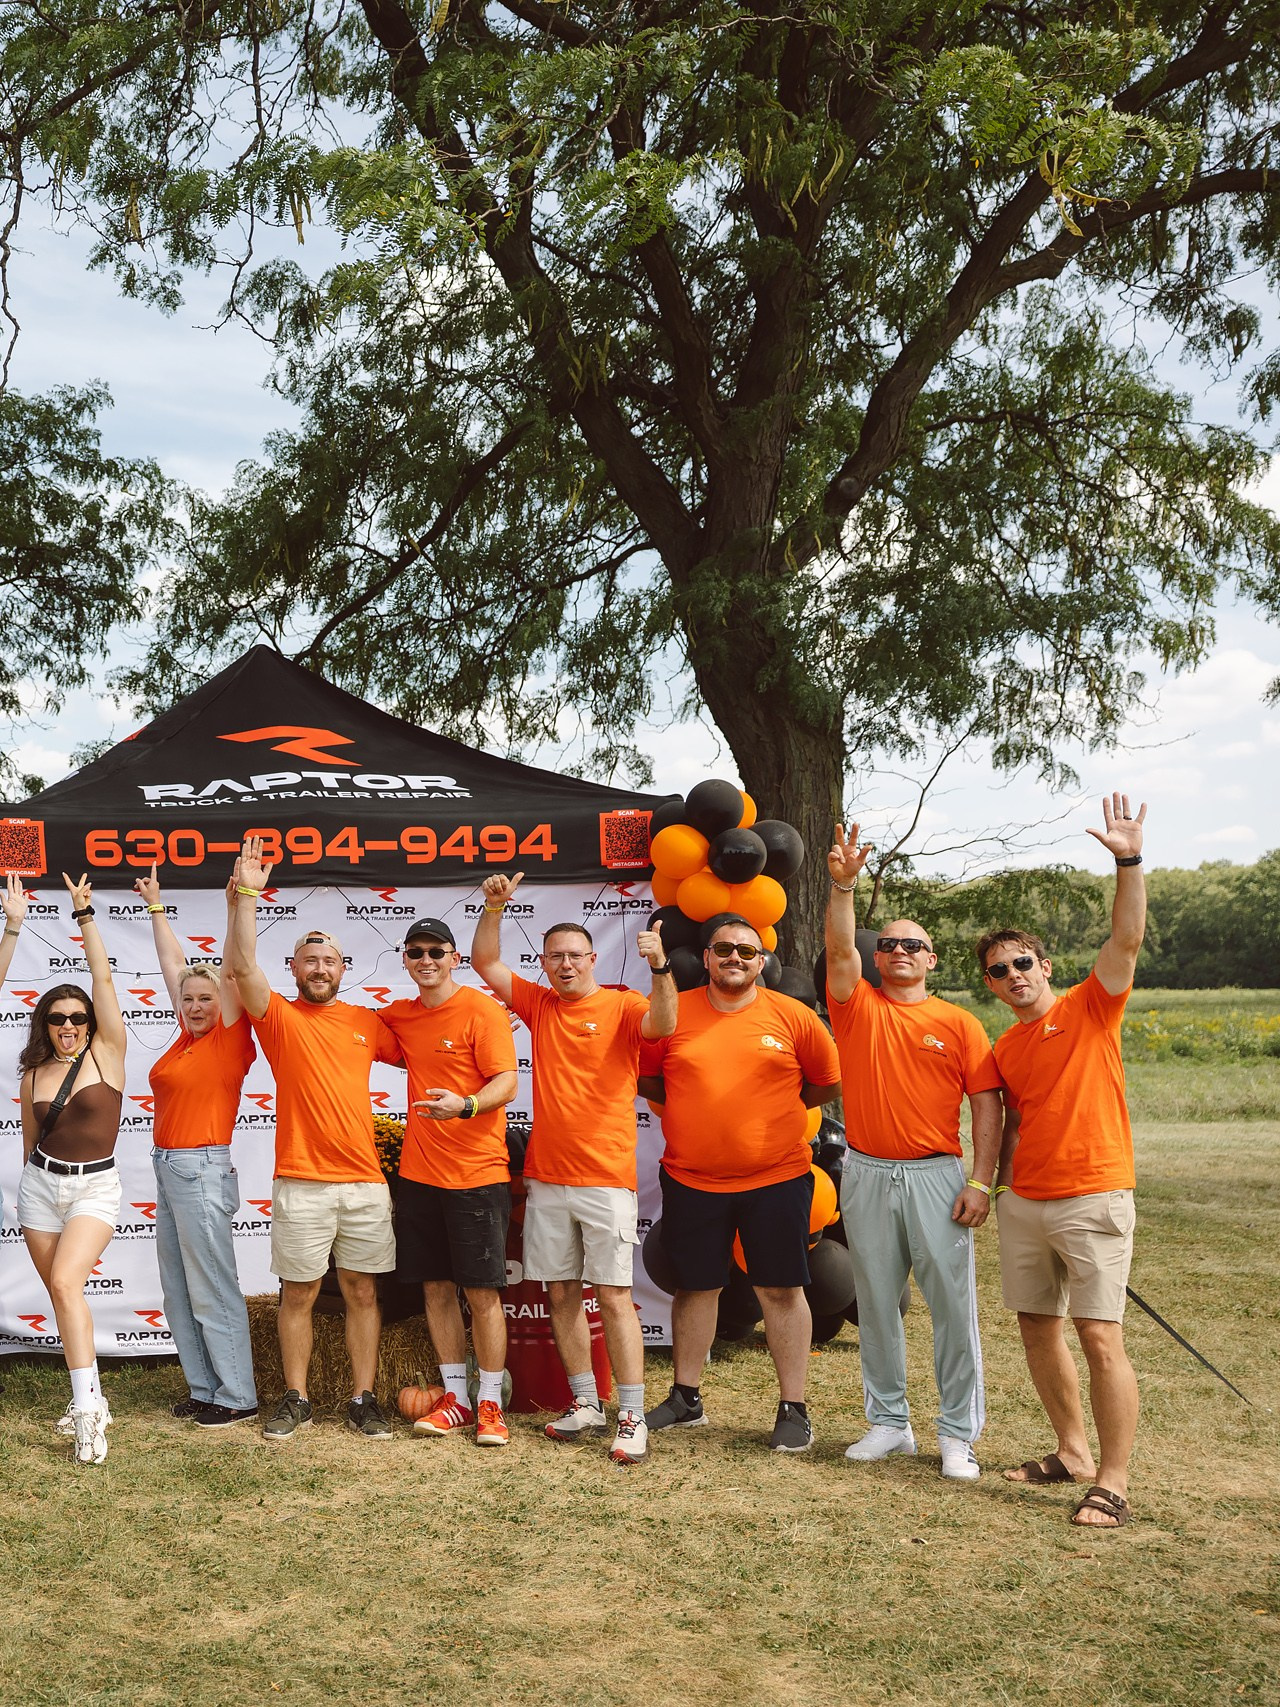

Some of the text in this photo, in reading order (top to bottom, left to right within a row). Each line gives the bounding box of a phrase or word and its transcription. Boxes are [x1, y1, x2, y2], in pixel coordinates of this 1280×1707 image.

[137, 771, 470, 800] RAPTOR
[144, 796, 234, 808] TRUCK
[263, 790, 372, 800] TRAILER
[377, 791, 473, 799] REPAIR
[85, 823, 558, 867] 630-894-9494
[583, 900, 653, 910] RAPTOR
[256, 906, 296, 914] PTOR
[346, 906, 415, 914] RAPTOR
[122, 1011, 175, 1019] APTOR
[121, 1117, 153, 1126] APT
[236, 1115, 276, 1123] APTO
[116, 1224, 156, 1232] RAPT
[232, 1222, 271, 1230] RAPT
[85, 1279, 123, 1288] PTOR
[503, 1304, 550, 1318] RAIL
[115, 1331, 171, 1341] RAPTO
